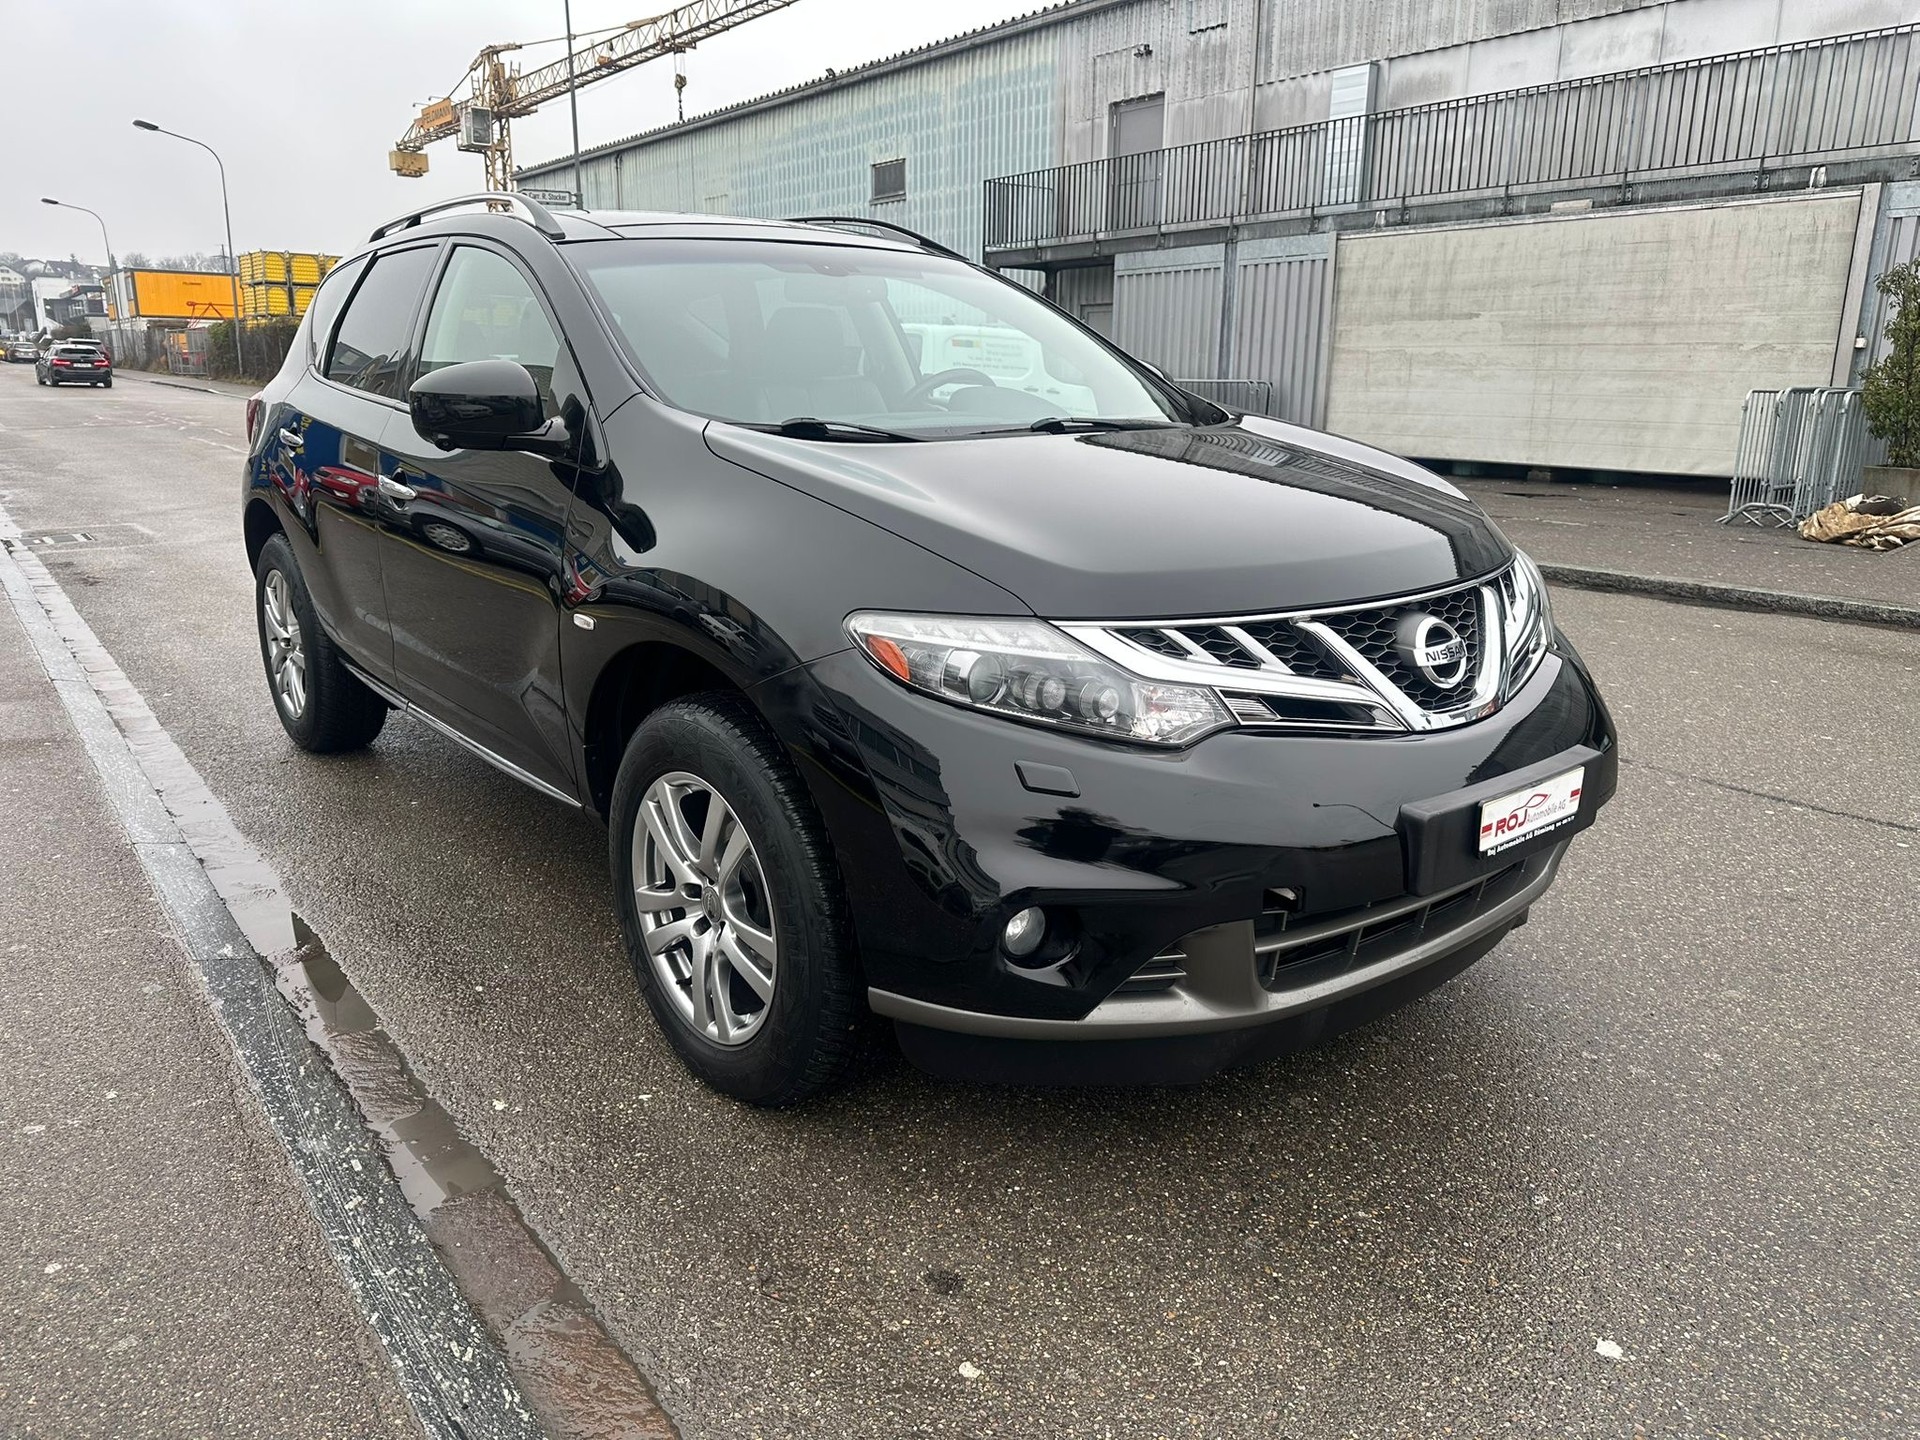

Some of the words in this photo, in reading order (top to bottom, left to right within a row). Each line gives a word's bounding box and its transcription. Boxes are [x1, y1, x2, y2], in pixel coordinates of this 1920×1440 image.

[1495, 808, 1528, 837] ROJ
[1487, 848, 1496, 857] Roj
[1497, 836, 1525, 853] Automobile
